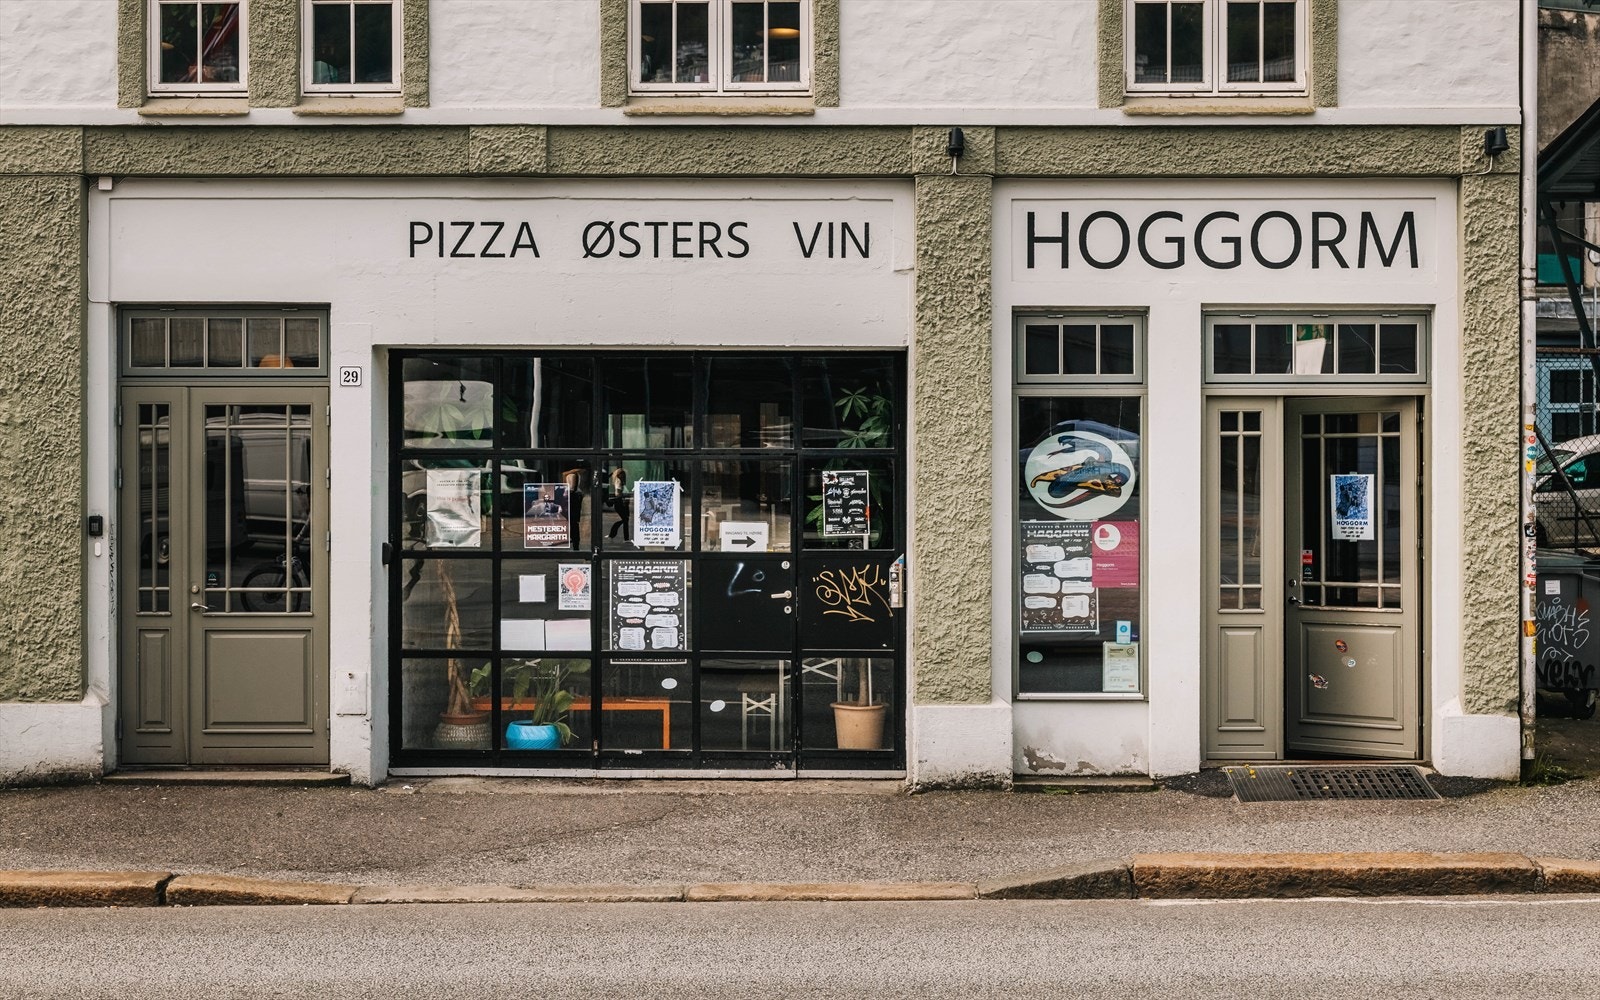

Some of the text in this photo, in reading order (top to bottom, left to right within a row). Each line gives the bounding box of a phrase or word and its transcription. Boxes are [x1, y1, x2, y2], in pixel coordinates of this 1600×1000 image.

[409, 220, 870, 259] PIZZA ØSTERS VIN
[1027, 211, 1419, 270] HOGGORM
[343, 371, 359, 383] 29
[527, 525, 567, 533] MESTEREN
[526, 533, 568, 541] MARGARITA
